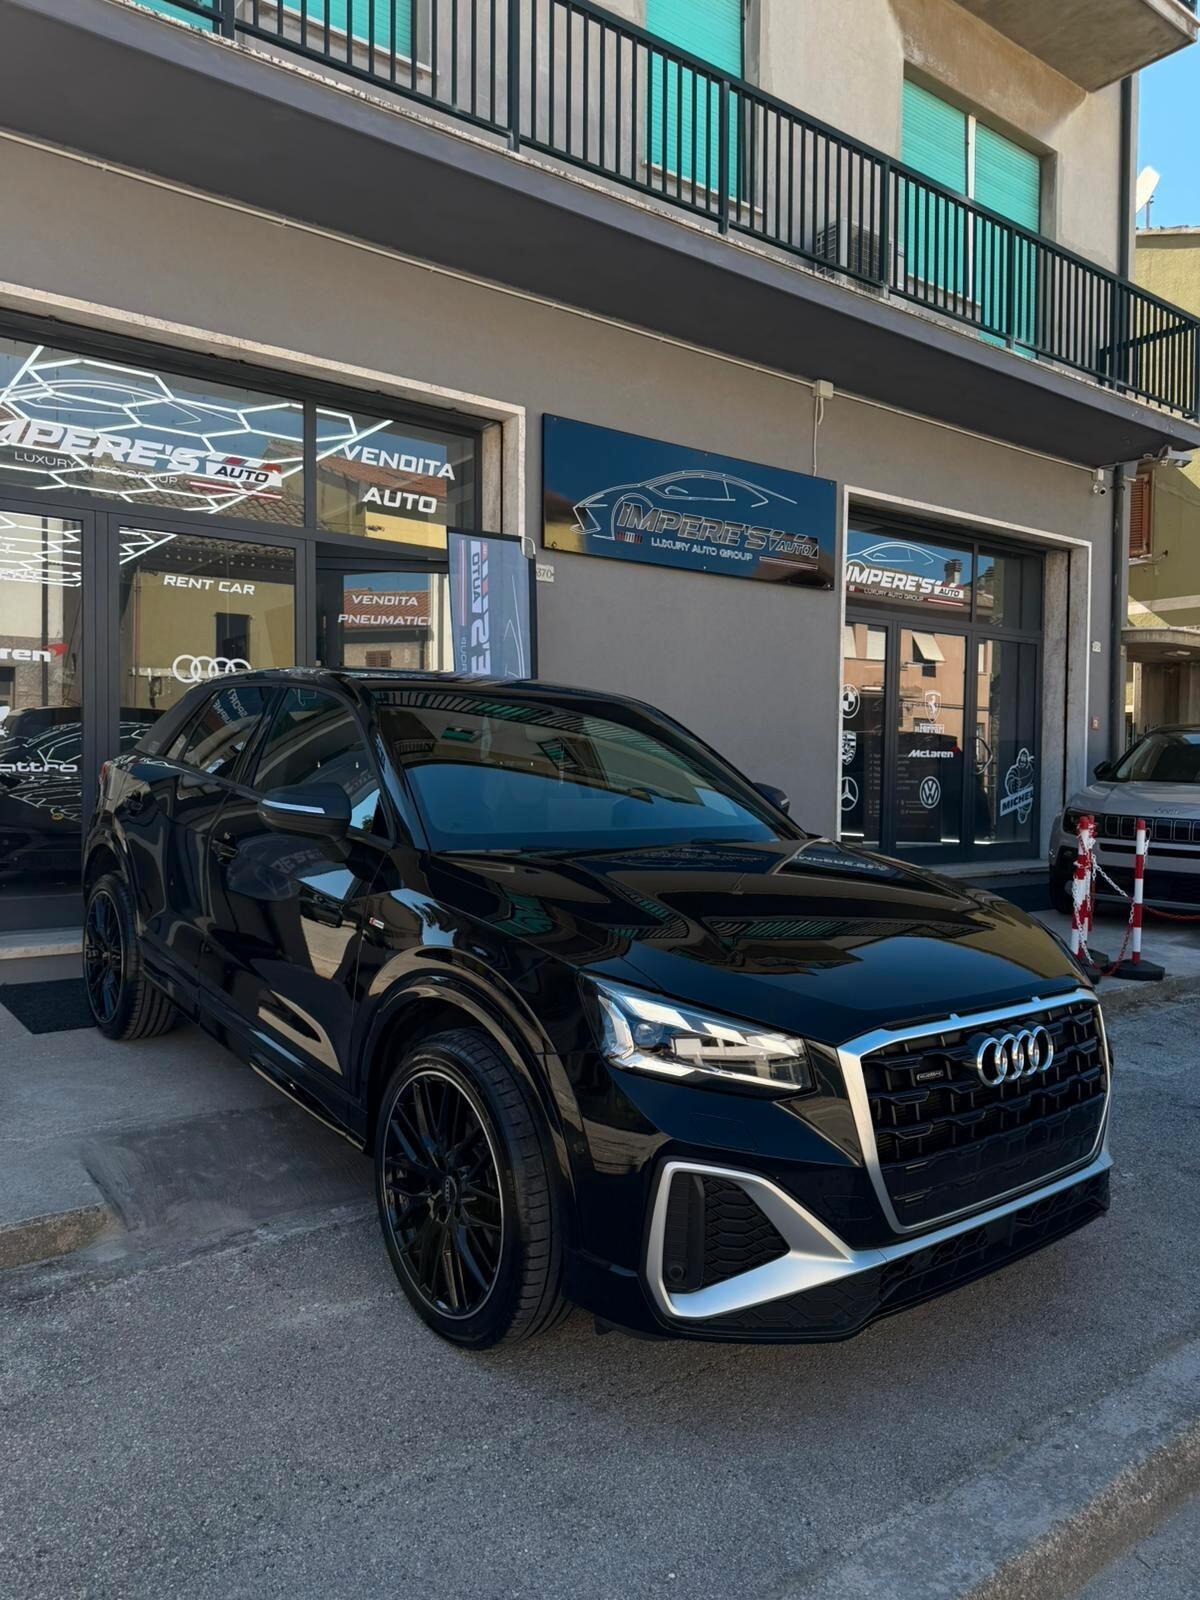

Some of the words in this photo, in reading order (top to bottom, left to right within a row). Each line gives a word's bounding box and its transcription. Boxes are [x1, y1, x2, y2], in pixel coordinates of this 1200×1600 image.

[14, 451, 77, 469] LUXURY
[343, 445, 456, 481] VENDITA
[213, 465, 269, 483] AUTO
[362, 486, 438, 514] AUTO
[616, 502, 769, 551] IMPERE'S
[776, 541, 812, 557] AUTO
[651, 537, 691, 552] LUXURY
[691, 543, 718, 557] AUTO
[719, 548, 753, 562] GROUP
[163, 574, 214, 591] RENT
[218, 581, 256, 596] CAR
[938, 587, 960, 598] AUTO
[351, 593, 418, 606] VENDITA
[908, 749, 954, 759] McLaren
